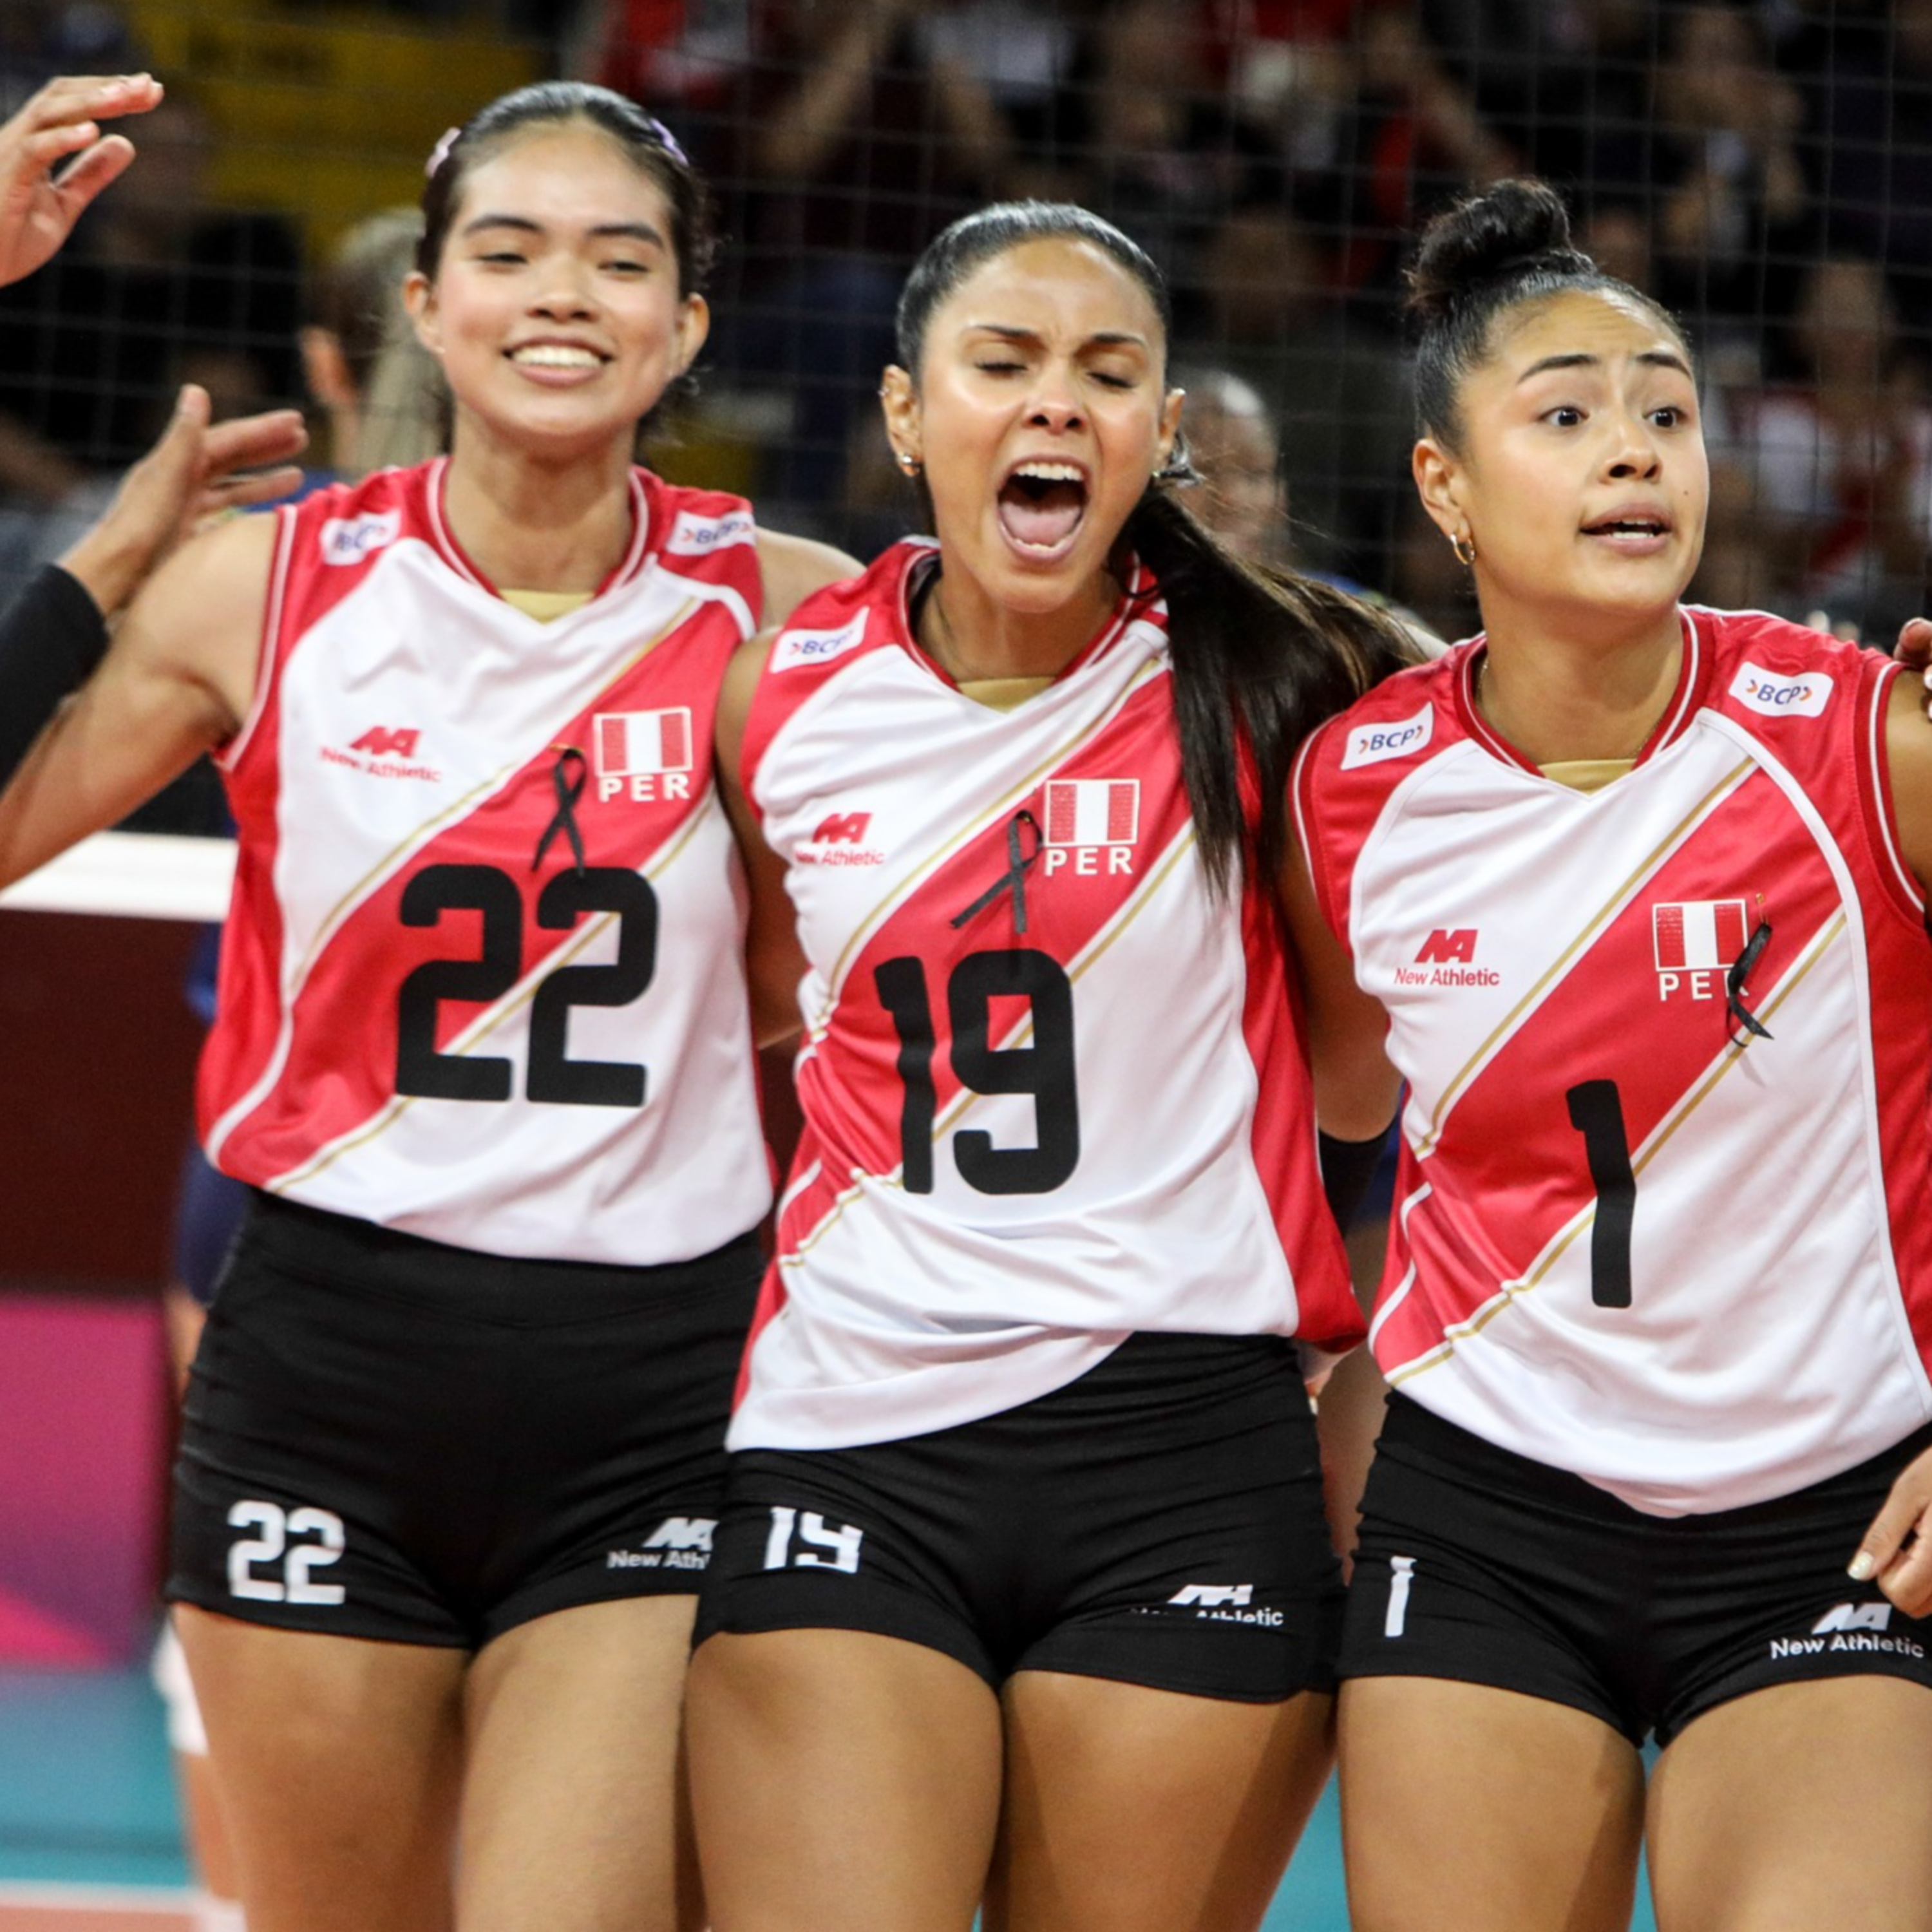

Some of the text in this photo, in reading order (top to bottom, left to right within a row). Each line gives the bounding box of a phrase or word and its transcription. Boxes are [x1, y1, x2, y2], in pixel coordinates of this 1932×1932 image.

[1757, 683, 1801, 705] BCP
[1370, 728, 1415, 751] BCP
[598, 773, 691, 803] PER
[822, 849, 886, 866] Athletic
[1045, 847, 1133, 877] PER
[395, 864, 660, 1108] 22
[1394, 967, 1501, 987] New Athletic
[874, 948, 1080, 1196] 19
[1566, 1079, 1636, 1309] 1
[227, 1499, 346, 1605] 22
[607, 1549, 662, 1569] New
[1385, 1555, 1417, 1638] 1
[1770, 1633, 1925, 1660] New Athletic
